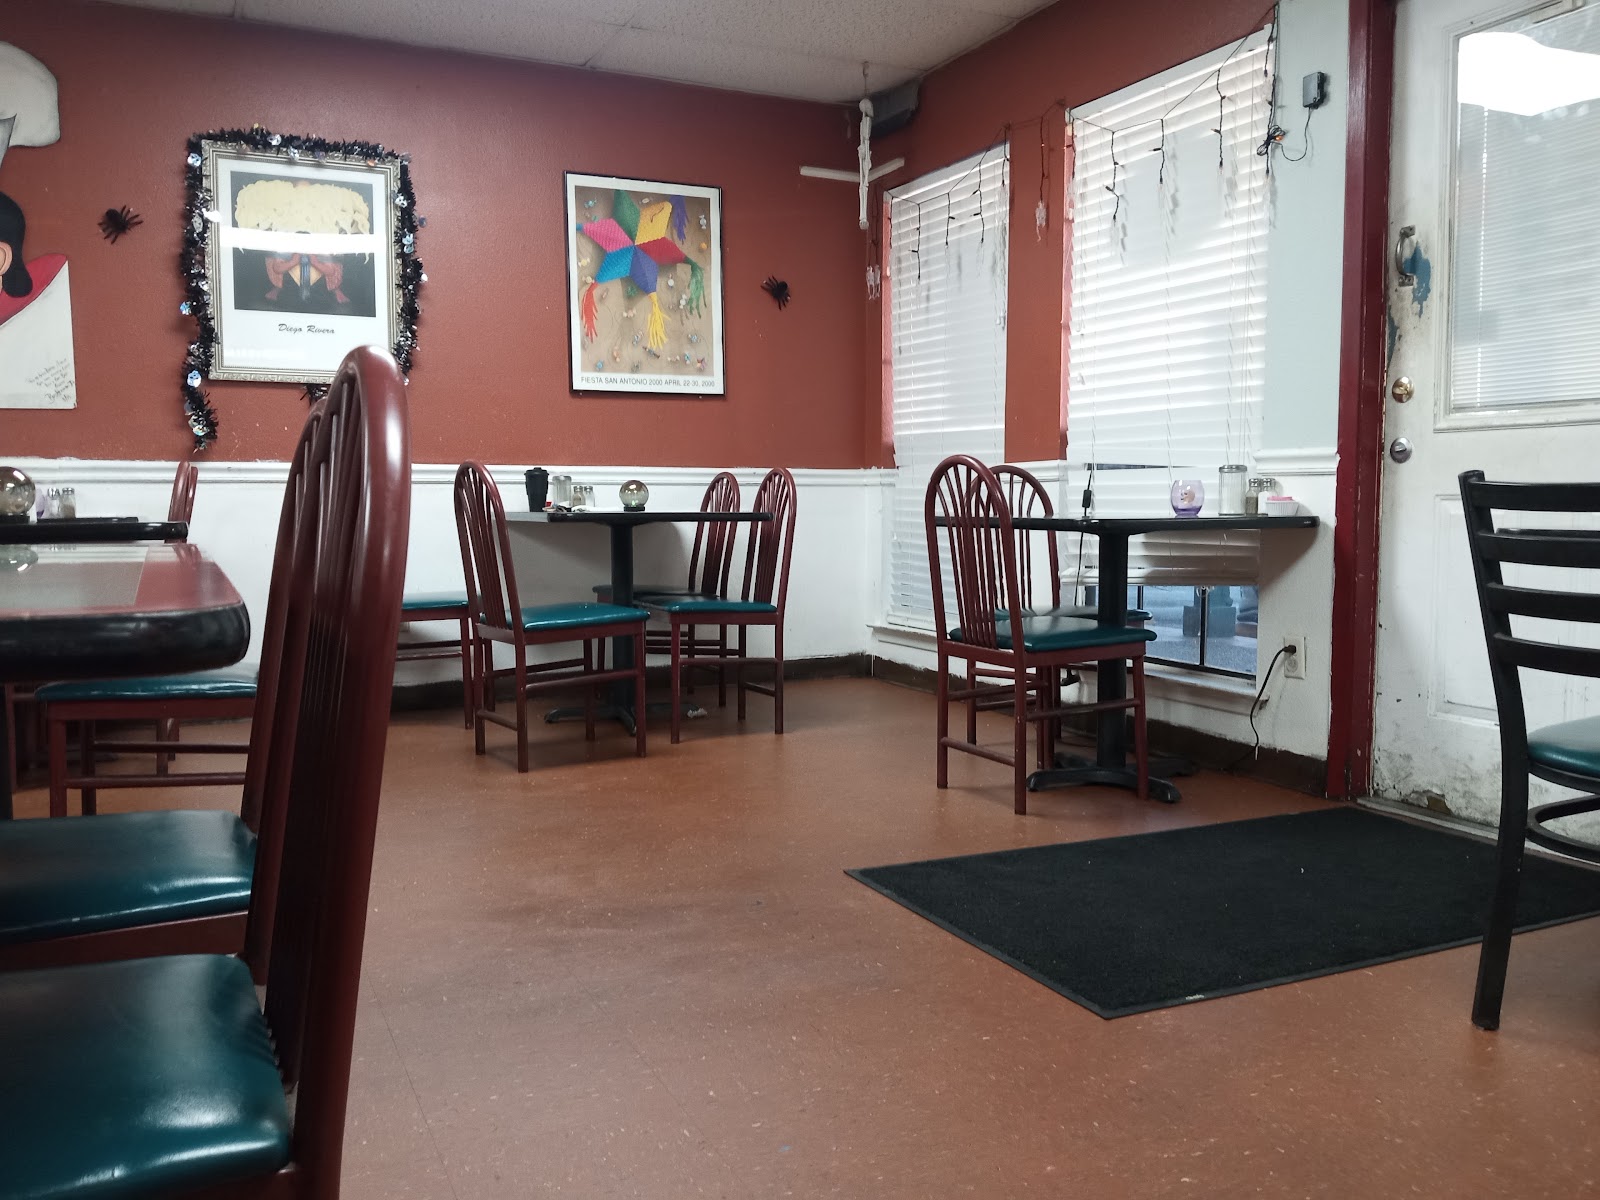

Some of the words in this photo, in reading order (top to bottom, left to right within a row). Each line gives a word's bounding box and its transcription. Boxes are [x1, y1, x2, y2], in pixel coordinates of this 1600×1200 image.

[278, 323, 303, 334] Diego
[306, 325, 335, 334] Rivera
[580, 376, 604, 384] FIESTA
[604, 376, 618, 385] SAN
[619, 377, 648, 386] ANTONIO
[648, 378, 663, 386] 2000
[664, 379, 682, 387] APRIL
[701, 380, 715, 388] 2000
